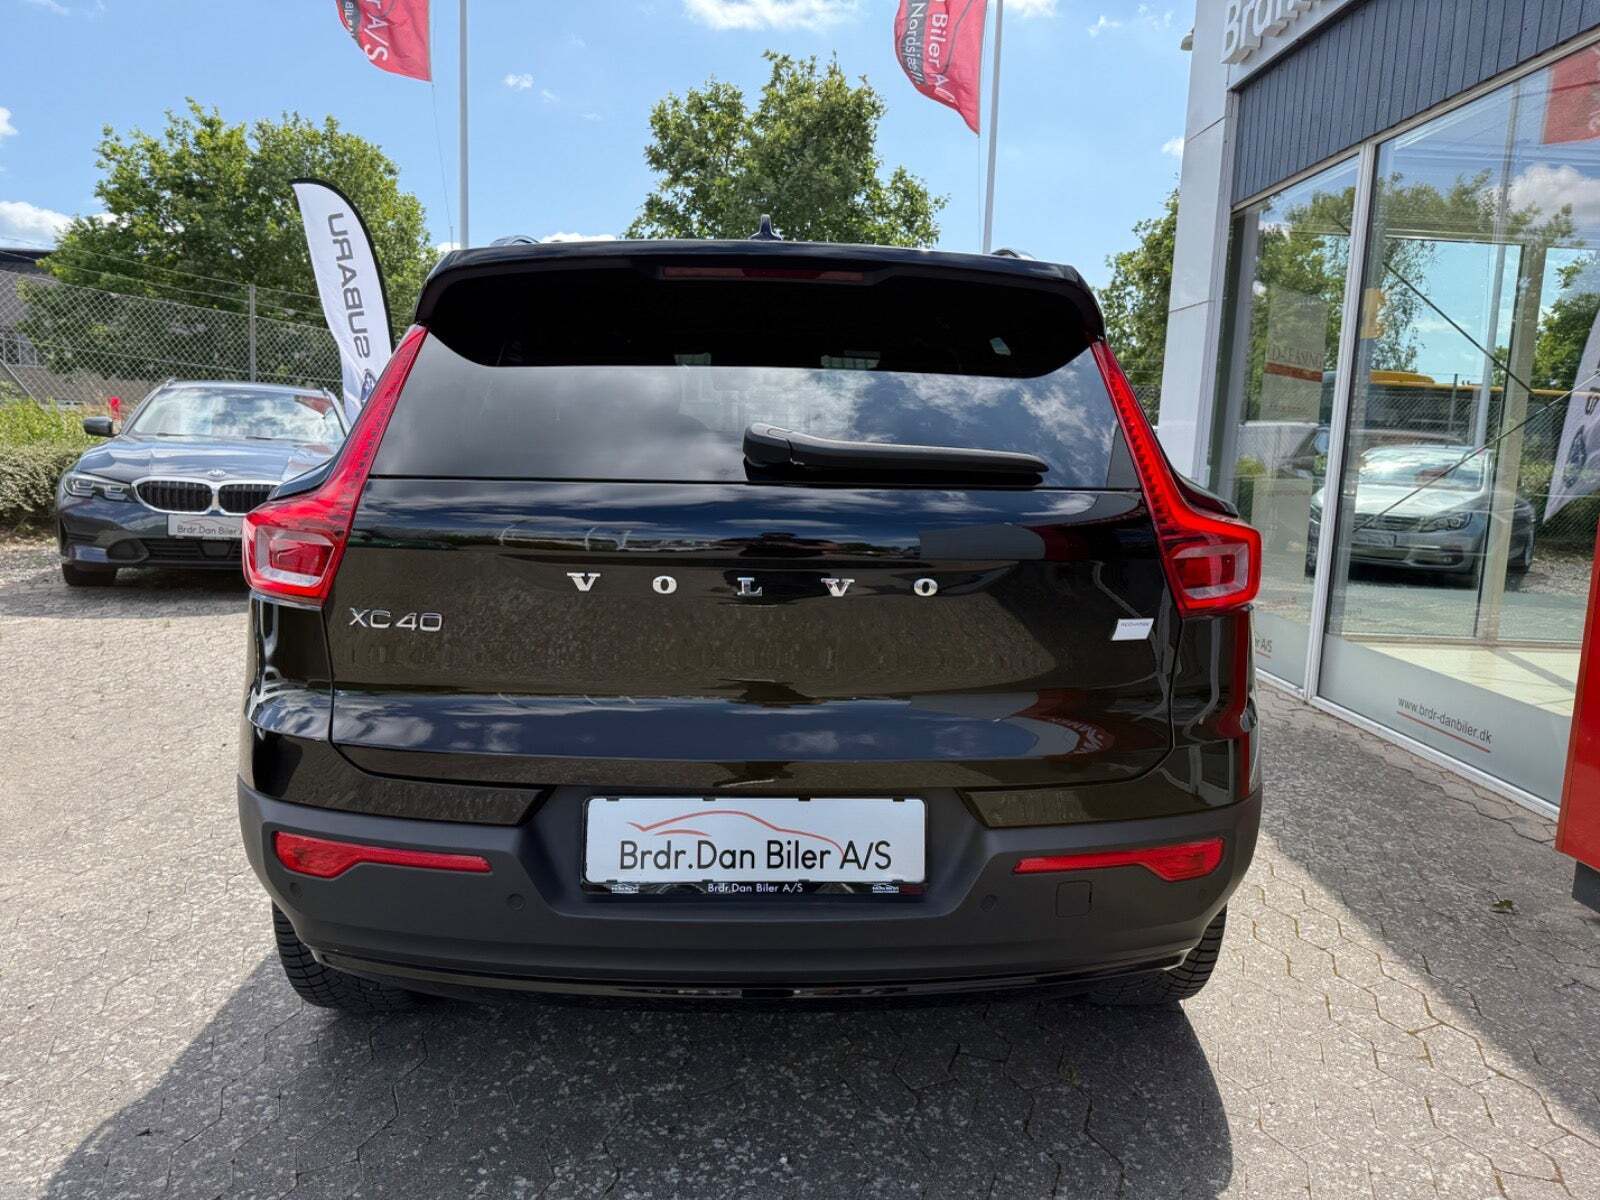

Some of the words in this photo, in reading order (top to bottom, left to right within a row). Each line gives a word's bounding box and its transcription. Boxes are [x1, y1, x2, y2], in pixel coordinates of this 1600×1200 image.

[364, 13, 389, 61] A/S
[928, 13, 949, 68] Biler
[567, 571, 938, 599] VOLVO
[349, 606, 443, 632] XC40
[1398, 697, 1492, 744] www.brdr-danbiler.dk
[619, 840, 755, 870] Brdr.Dan
[766, 840, 831, 870] Biler
[839, 840, 892, 871] A/S
[756, 883, 778, 893] Biler
[783, 883, 803, 893] A/S
